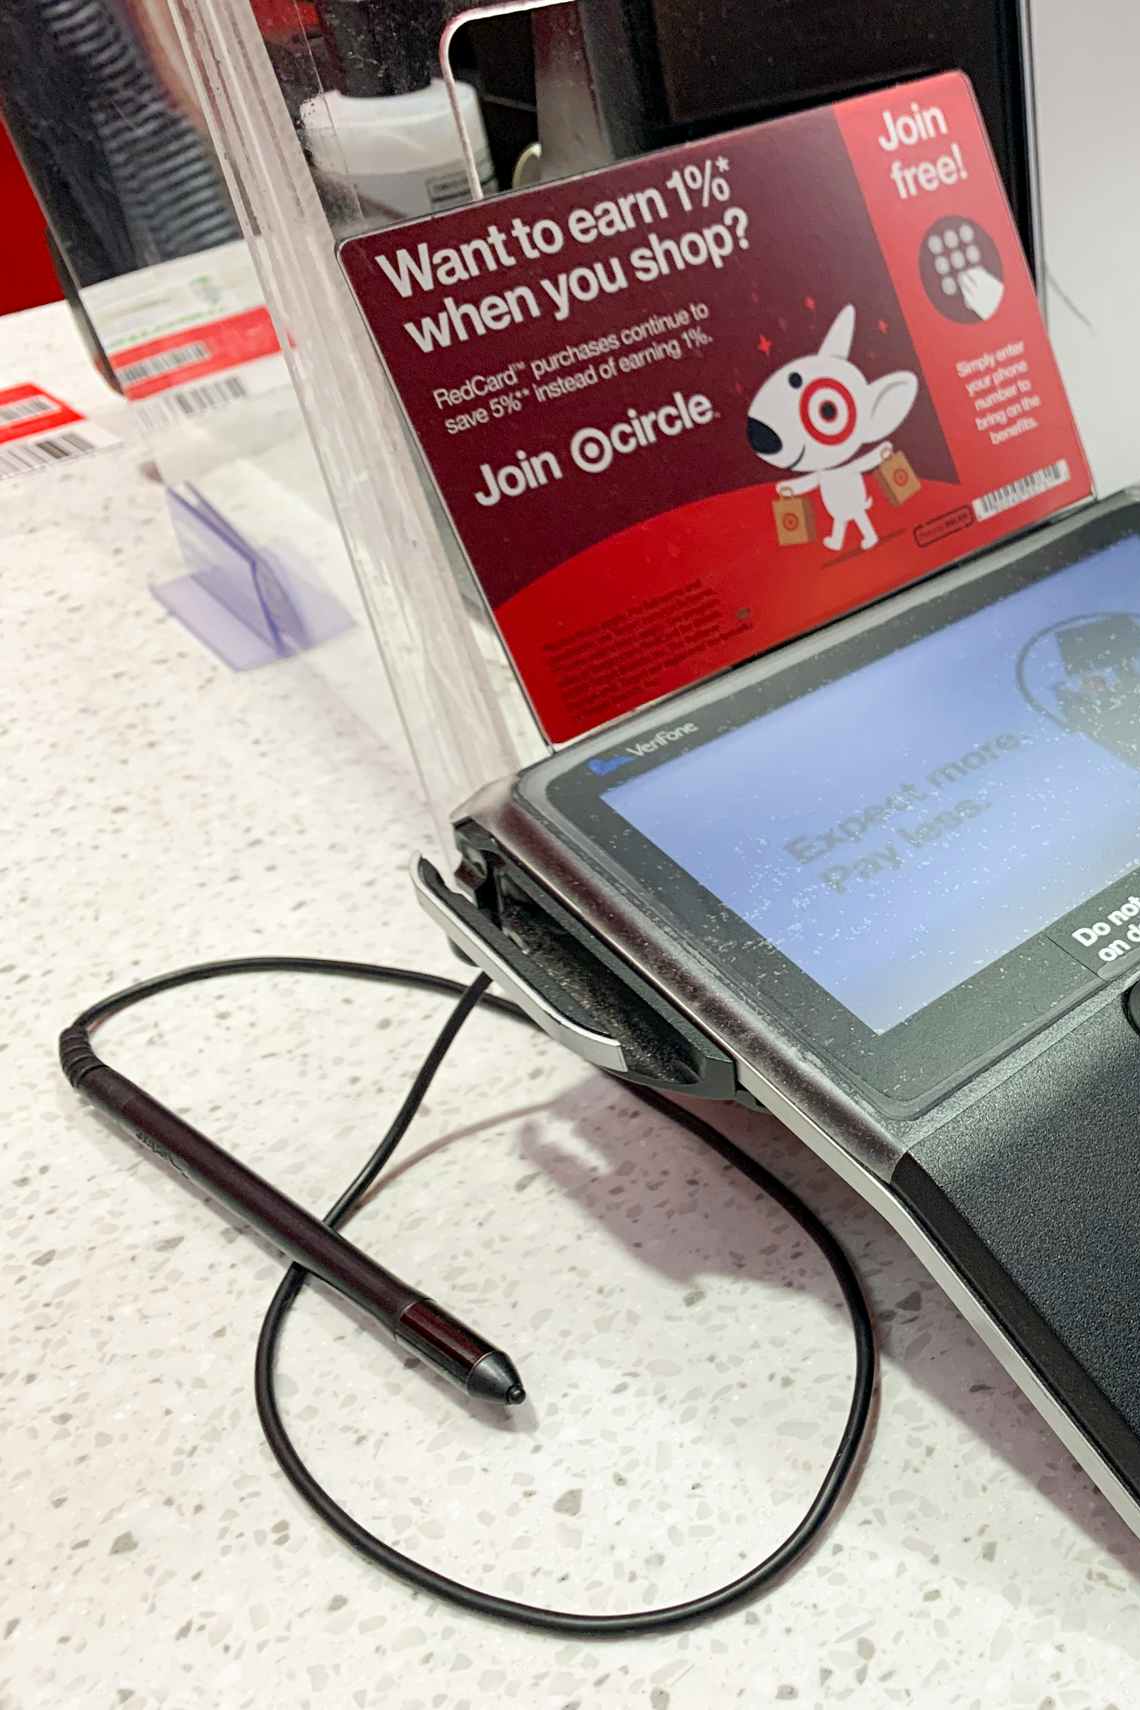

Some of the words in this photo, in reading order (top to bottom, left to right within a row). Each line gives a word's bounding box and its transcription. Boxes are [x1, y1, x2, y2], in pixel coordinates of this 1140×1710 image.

[878, 101, 948, 151] Join
[890, 142, 969, 199] free!
[375, 224, 516, 298] Want
[511, 217, 565, 260] to
[567, 187, 669, 243] earn
[404, 285, 542, 353] when
[540, 256, 629, 321] you
[629, 206, 750, 281] shop?
[530, 332, 621, 381] purchases
[620, 310, 690, 345] continue
[690, 301, 710, 321] to
[955, 352, 996, 378] Simply
[995, 340, 1025, 361] enter
[444, 408, 491, 434] save
[532, 364, 599, 403] instead
[599, 354, 618, 380] of
[618, 339, 683, 373] earning
[681, 326, 714, 352] 1%.
[965, 374, 992, 398] your
[991, 360, 1029, 386] phone
[974, 384, 1018, 410] number
[1017, 379, 1032, 393] to
[975, 410, 1008, 432] bring
[1006, 402, 1023, 418] on
[1021, 394, 1041, 411] the
[474, 450, 564, 507] Join
[610, 391, 715, 454] circle
[782, 783, 923, 865] Expect
[817, 844, 903, 897] Pay
[1071, 920, 1112, 948] Do
[1098, 939, 1131, 962] on
